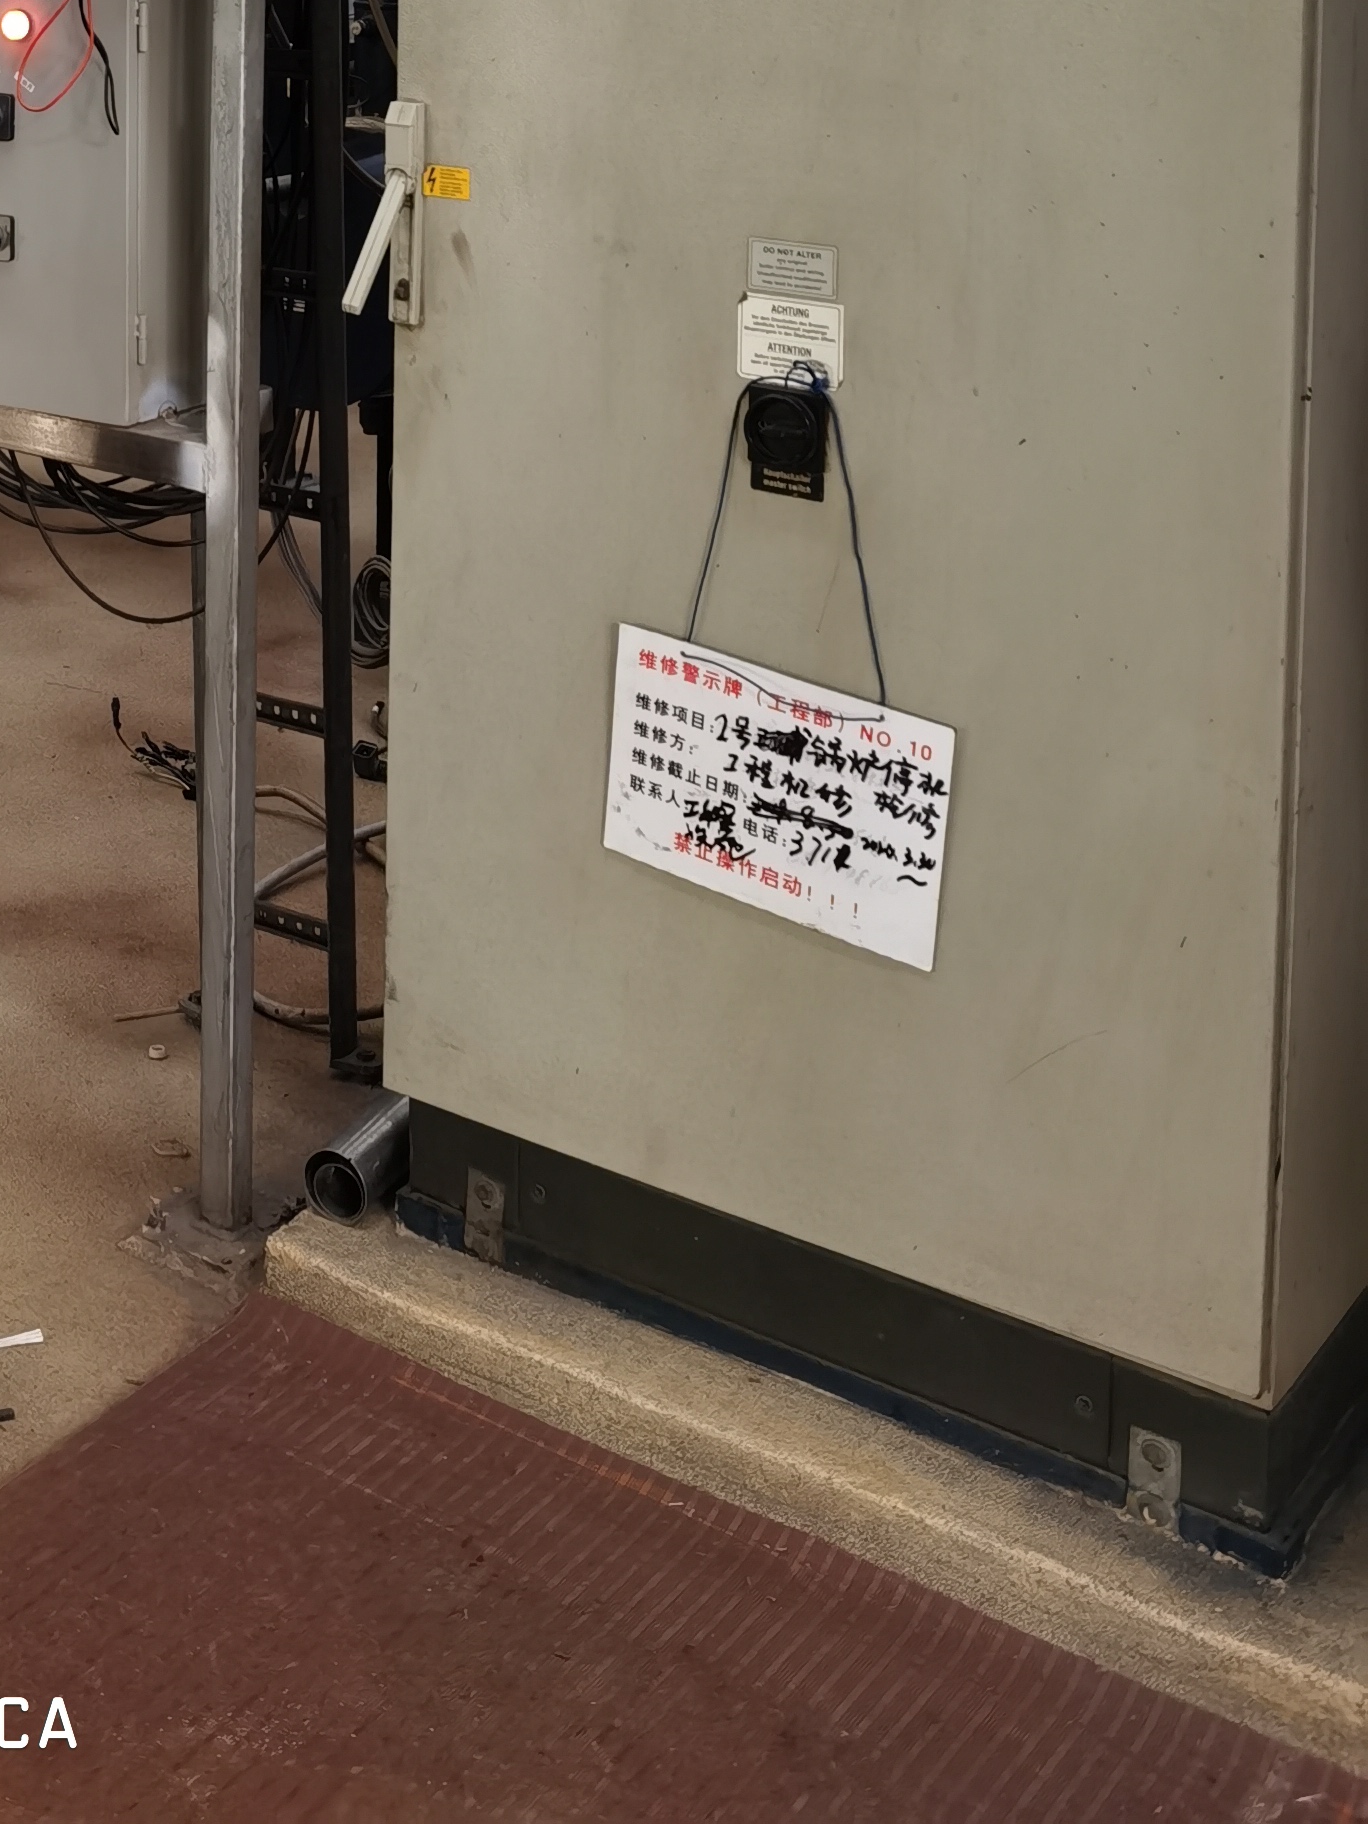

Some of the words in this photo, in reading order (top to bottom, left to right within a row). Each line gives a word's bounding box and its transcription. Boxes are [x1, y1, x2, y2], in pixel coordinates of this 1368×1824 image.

[771, 304, 810, 318] ACHTUNG
[767, 341, 812, 357] ATTENTION
[638, 648, 743, 699] 维修警示牌
